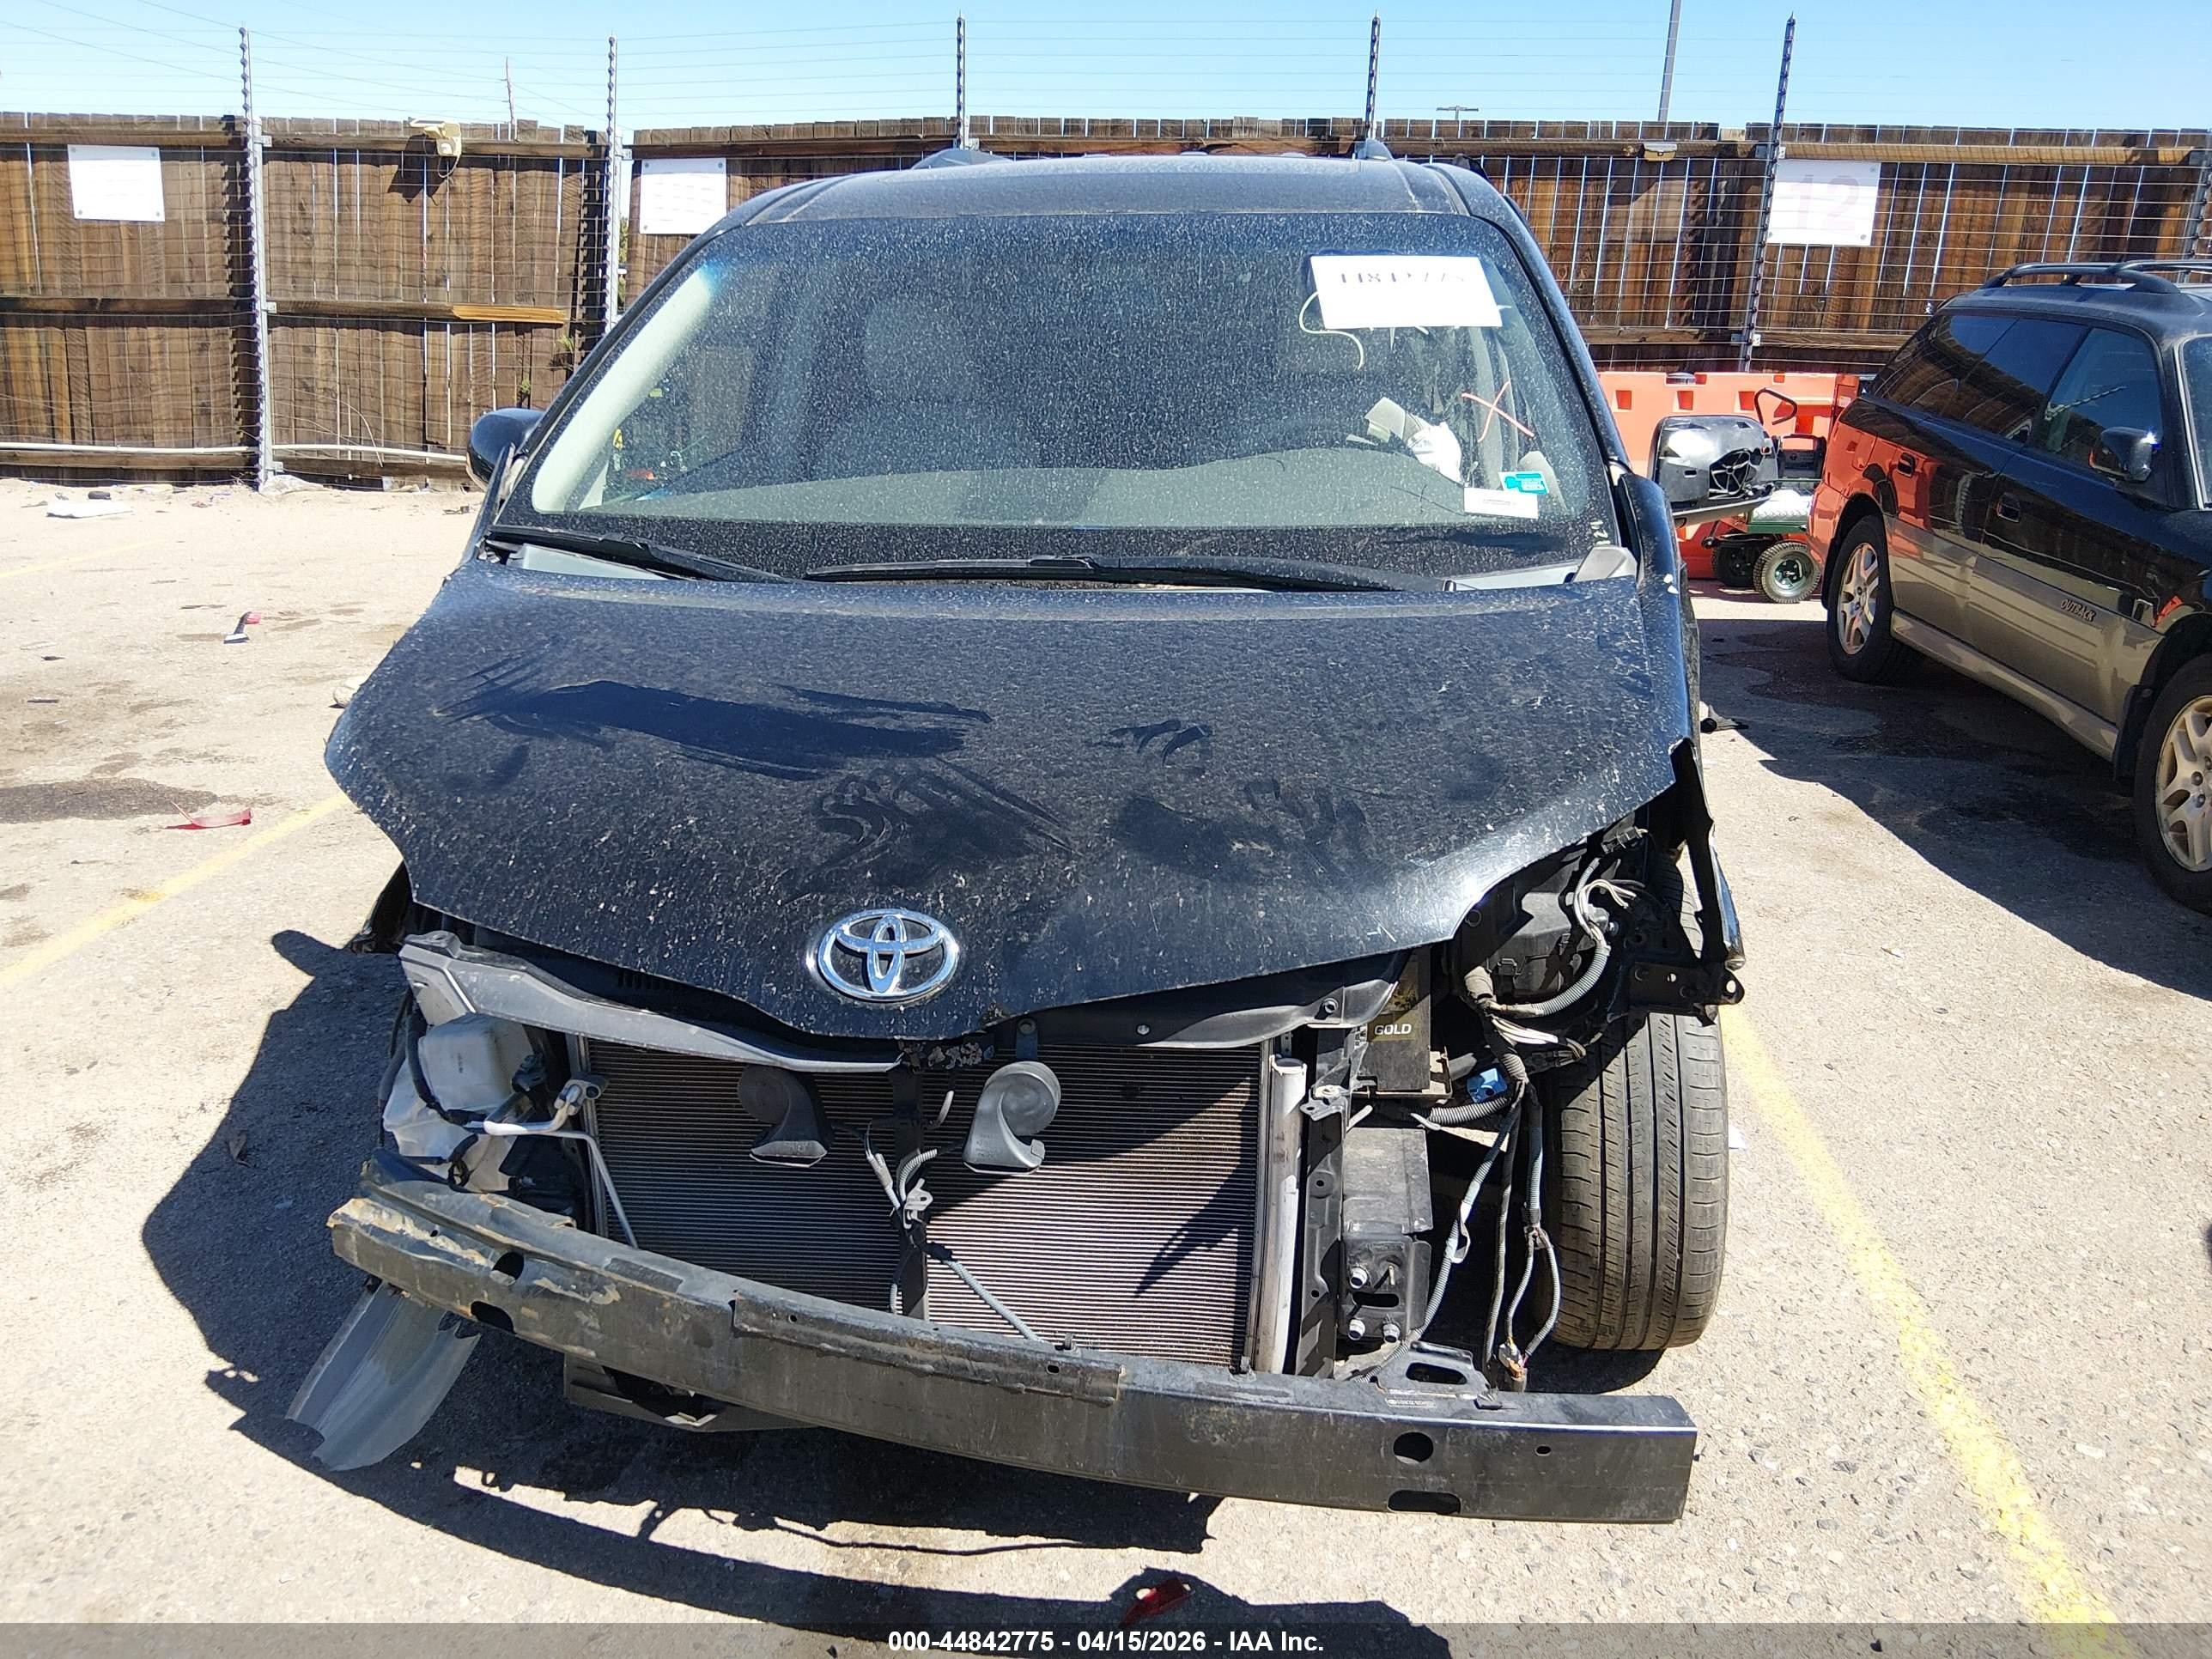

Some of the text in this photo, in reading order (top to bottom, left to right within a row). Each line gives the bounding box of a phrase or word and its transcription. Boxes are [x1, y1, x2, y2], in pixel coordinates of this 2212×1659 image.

[1792, 174, 1861, 233] 12
[2062, 599, 2096, 622] OUTBACK
[1375, 1024, 1412, 1035] GOLD
